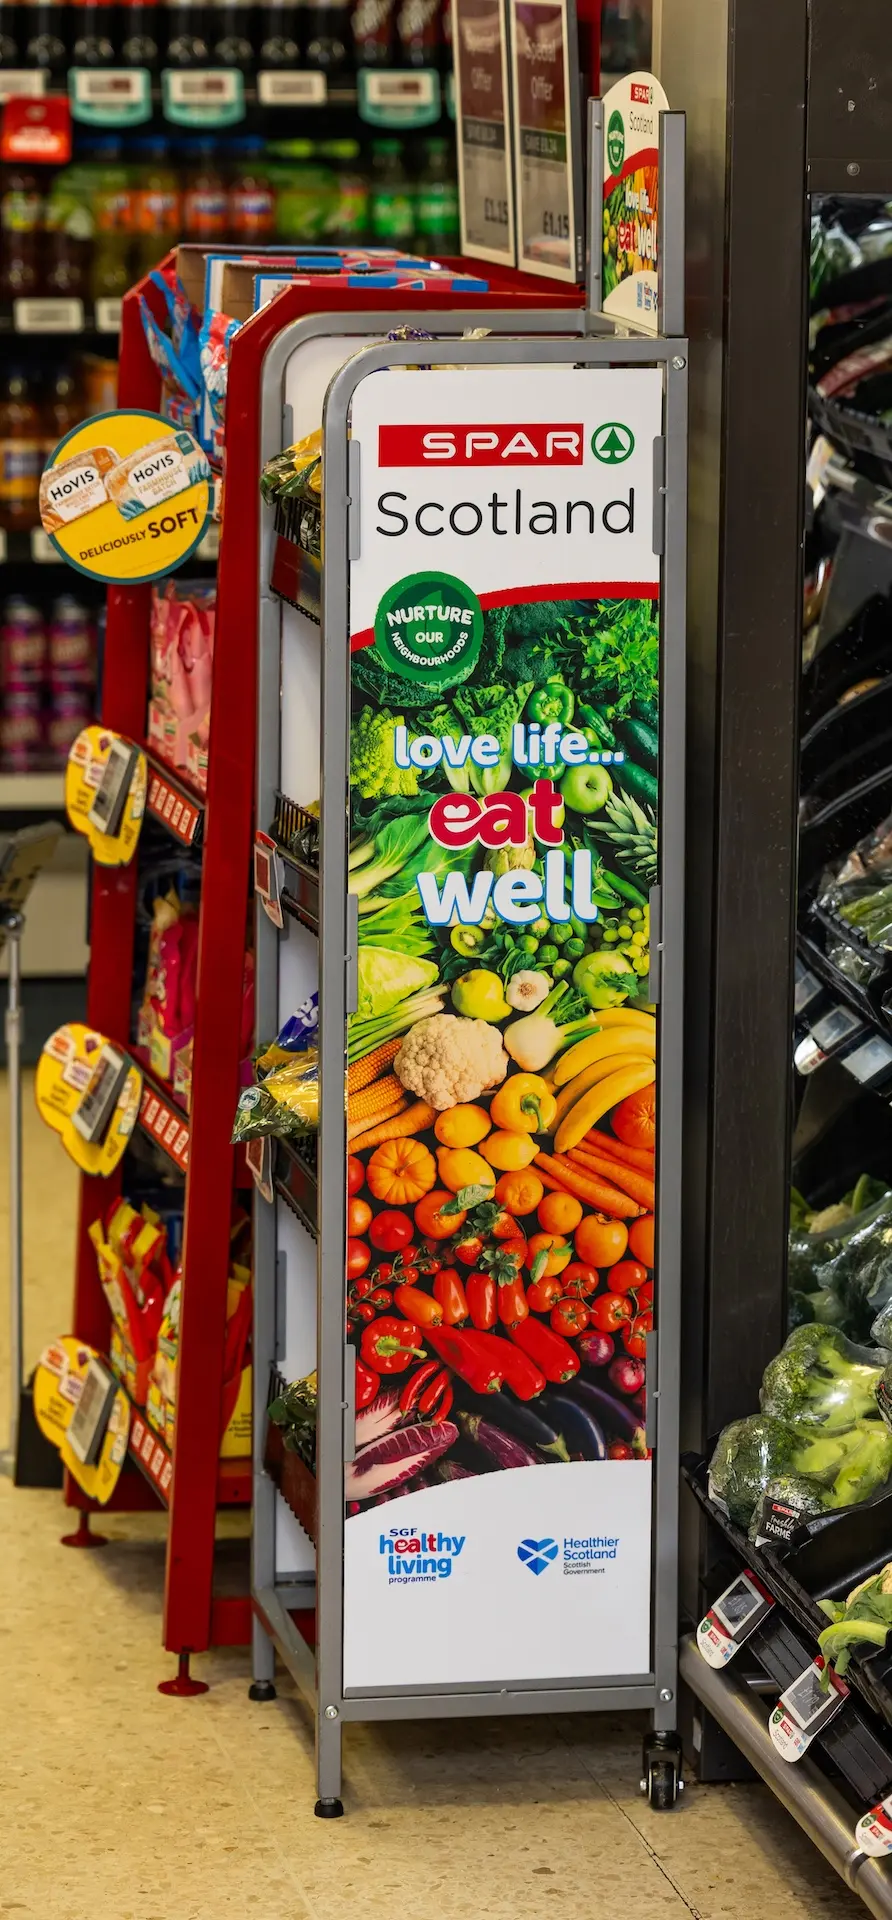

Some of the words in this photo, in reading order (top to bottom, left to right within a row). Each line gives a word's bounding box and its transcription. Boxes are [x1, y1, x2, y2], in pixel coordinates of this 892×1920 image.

[525, 37, 557, 65] Special
[530, 75, 554, 101] Offer
[629, 111, 653, 134] Scotland
[543, 210, 569, 239] £1.15
[618, 218, 636, 252] eat
[638, 219, 657, 262] well
[422, 430, 581, 460] SPAR
[138, 467, 183, 494] FARMHOUSE
[376, 487, 635, 537] Scotland
[79, 530, 147, 561] DELICIOUSLY
[148, 507, 199, 539] SOFT
[386, 604, 475, 628] NURTURE
[391, 631, 469, 667] NEIGHBOURHOODS
[415, 630, 444, 644] OUR
[394, 725, 500, 769] love
[512, 722, 625, 767] life...
[428, 778, 566, 850] eat
[416, 848, 599, 928] well
[379, 1532, 466, 1556] healthy
[389, 1528, 418, 1537] SGF
[563, 1537, 619, 1549] Healthier
[388, 1555, 452, 1578] living
[563, 1548, 617, 1561] Scotland
[563, 1561, 591, 1569] Scottish
[388, 1575, 437, 1585] programme
[563, 1567, 605, 1576] Government
